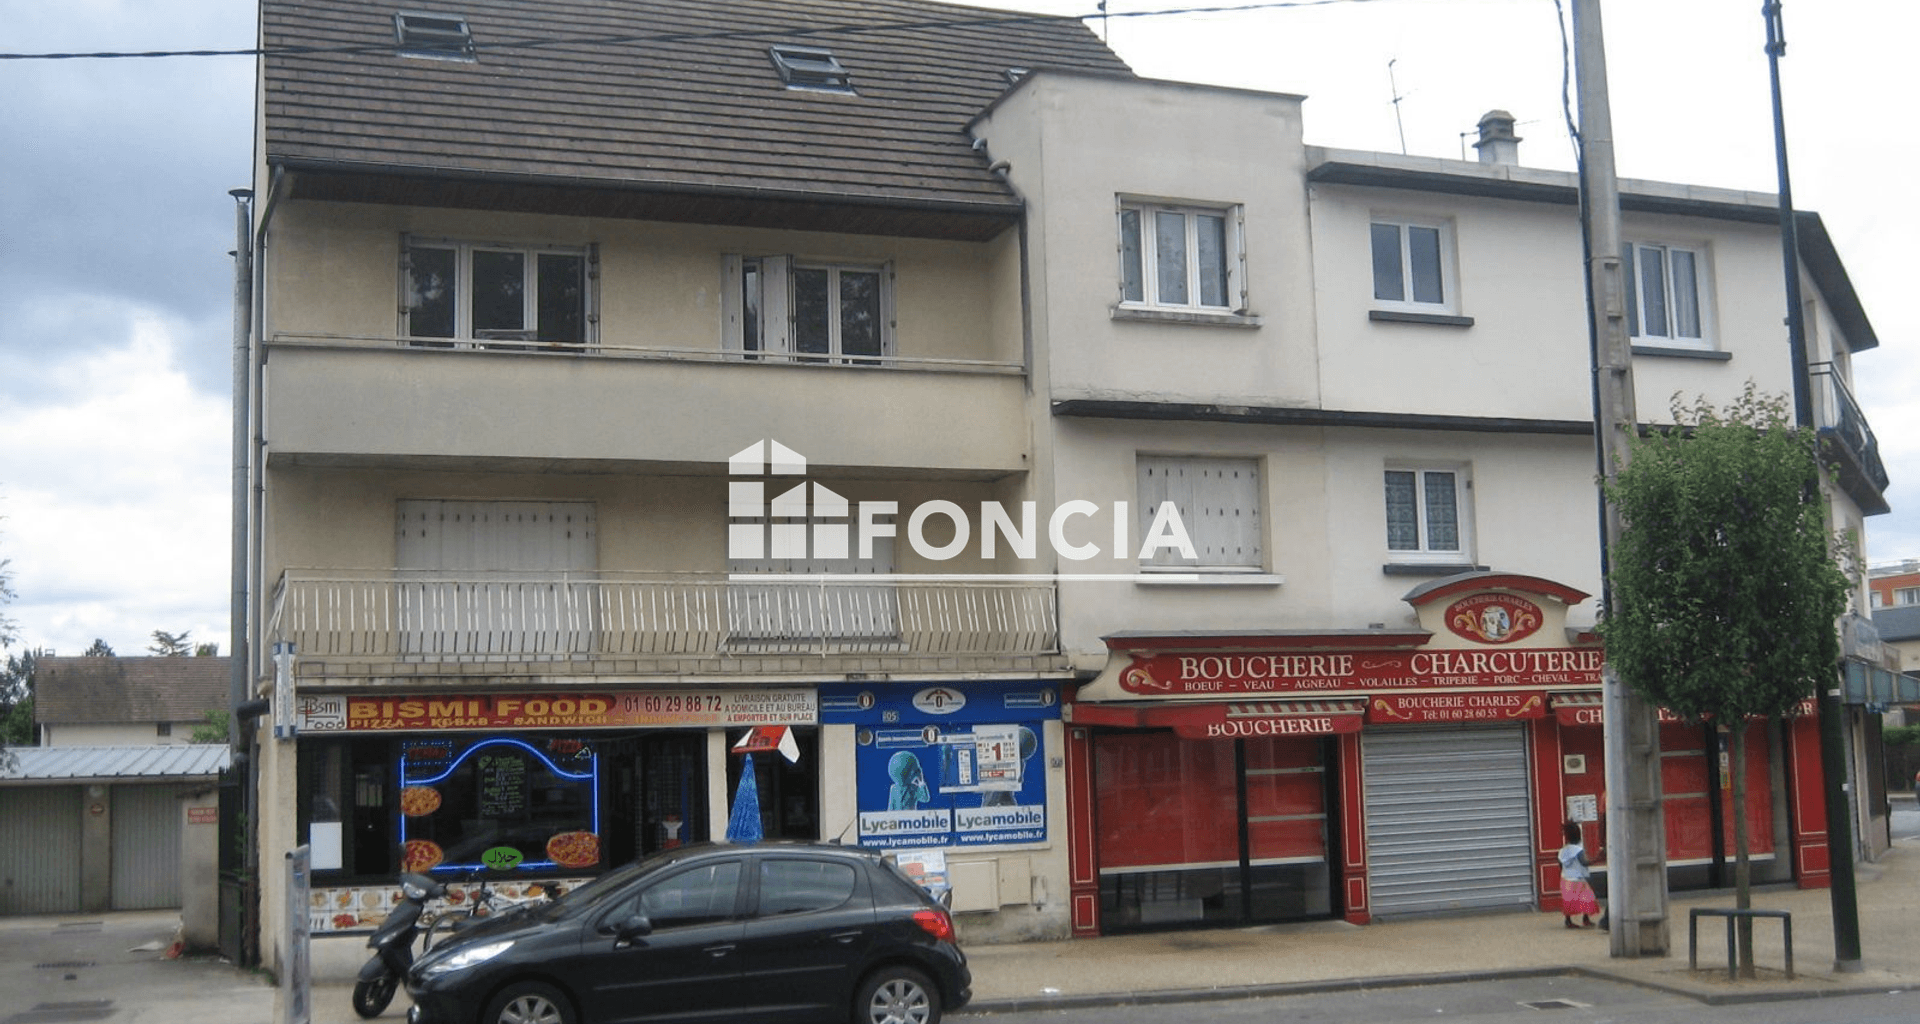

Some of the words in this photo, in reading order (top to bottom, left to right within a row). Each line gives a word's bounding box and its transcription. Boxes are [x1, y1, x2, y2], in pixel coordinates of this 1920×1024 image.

[1455, 596, 1498, 611] BOUCHERIE
[1499, 596, 1533, 611] CHARLES
[1179, 655, 1355, 680] BOUCHERIE
[1411, 651, 1602, 675] CHARCUTERIE
[1185, 681, 1223, 691] BOEUF
[1244, 680, 1275, 690] VEAU
[1295, 678, 1342, 689] AGNEAU
[1360, 676, 1418, 688] VOLAILLES
[1433, 675, 1478, 686] TRIPERIE
[1494, 674, 1521, 684] PORC
[1532, 673, 1571, 683] CHEVAL
[625, 696, 639, 712] 01
[645, 695, 661, 712] 60
[665, 695, 681, 712] 29
[686, 695, 702, 712] 88
[706, 695, 722, 712] 72
[734, 694, 771, 703] LIVRAISON
[772, 693, 806, 702] GRATUITE
[1398, 696, 1464, 708] BOUCHERIE
[1469, 696, 1520, 707] CHARLES
[349, 701, 479, 719] BISMI
[497, 699, 607, 717] FOOD
[736, 703, 764, 713] DOMICILE
[766, 703, 774, 712] ET
[777, 703, 785, 712] AU
[788, 702, 815, 712] BUREAU
[1440, 710, 1450, 719] 01
[1452, 710, 1462, 718] 60
[1476, 709, 1486, 718] 60
[1487, 708, 1498, 717] 55
[350, 719, 405, 729] PIZZA
[513, 716, 608, 726] SANDWICH
[734, 713, 768, 722] EMPORTER
[770, 713, 777, 722] ET
[779, 713, 792, 721] SUR
[794, 712, 814, 721] PLACE
[1208, 718, 1333, 737] BOUCHERIE
[862, 815, 948, 833] Lycamobile
[957, 811, 1041, 829] Lycamobile
[862, 836, 948, 847] www.lycamobile.fr
[961, 830, 1043, 842] www.lycamobile.fr
